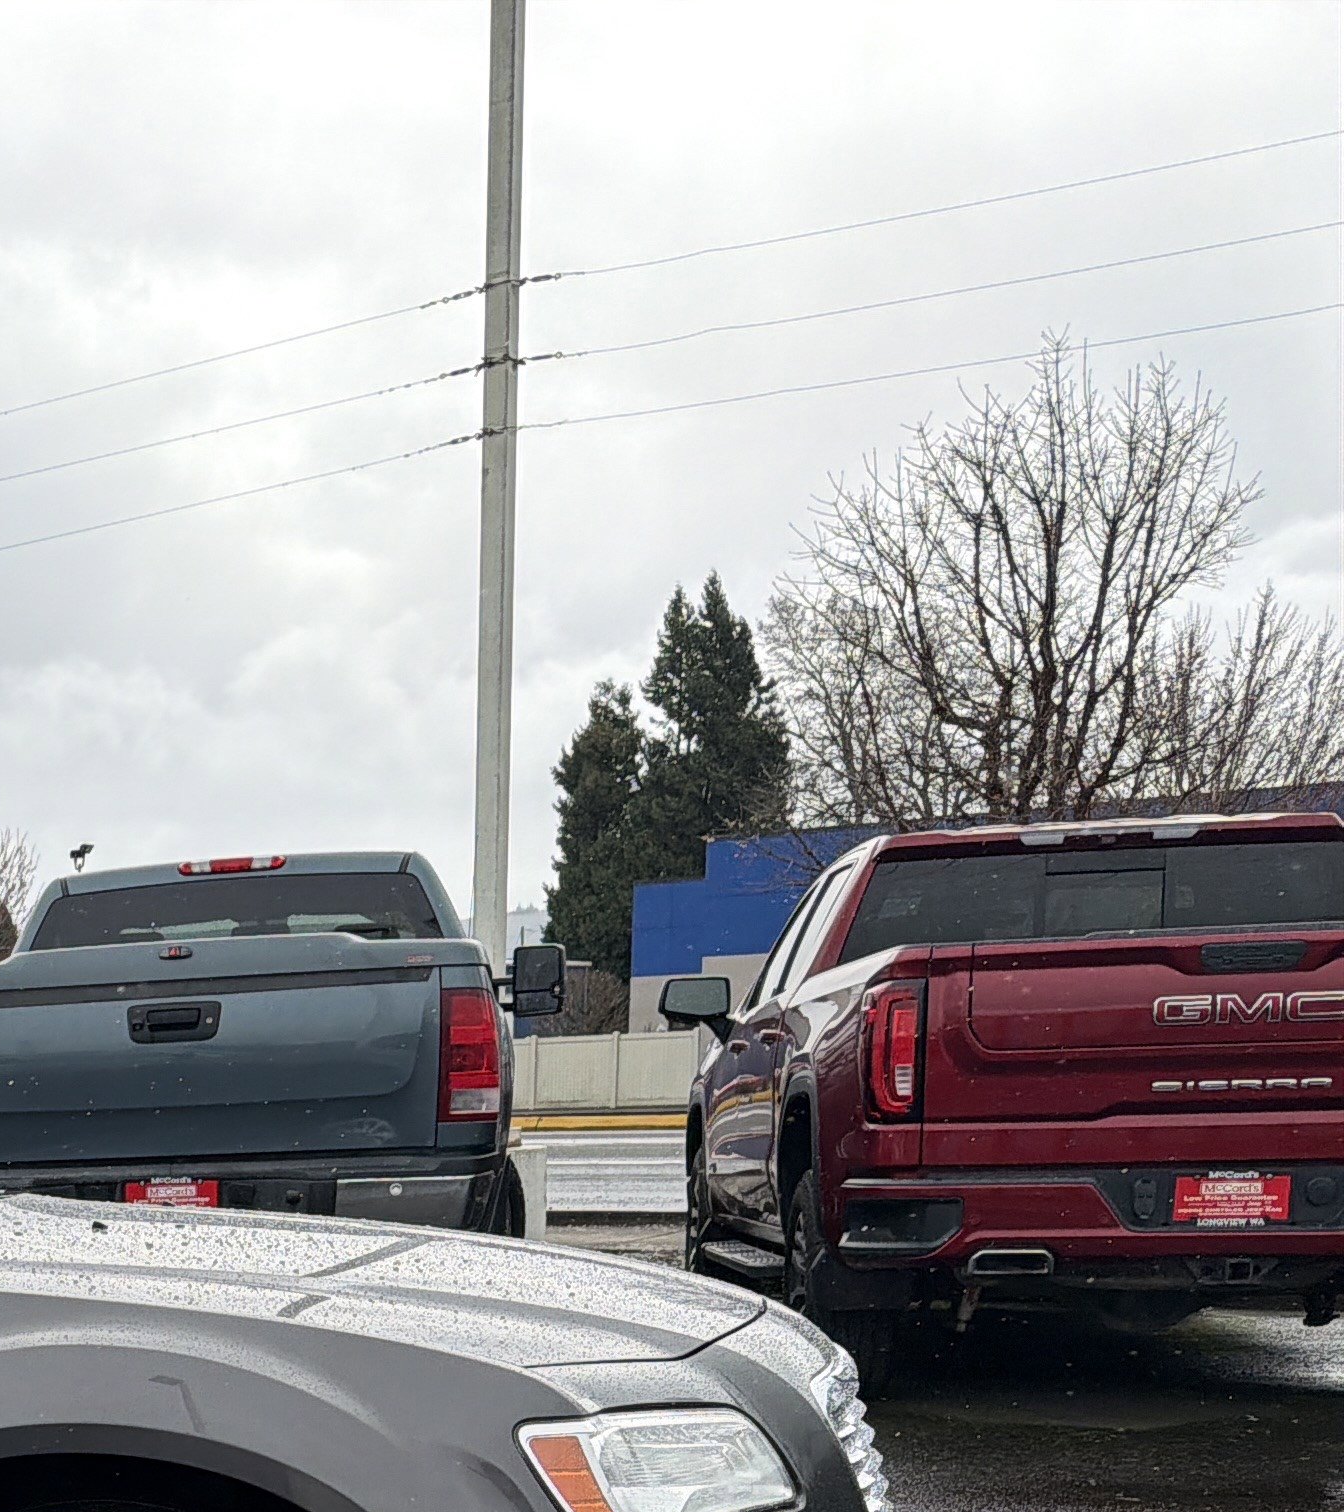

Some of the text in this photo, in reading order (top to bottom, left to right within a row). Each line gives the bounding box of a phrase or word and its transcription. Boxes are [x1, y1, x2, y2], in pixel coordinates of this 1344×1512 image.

[1153, 990, 1344, 1026] GMC
[1151, 1077, 1333, 1092] SIERRA
[1204, 1184, 1260, 1193] McCord's
[1196, 1218, 1265, 1227] LONGVIEW WA
